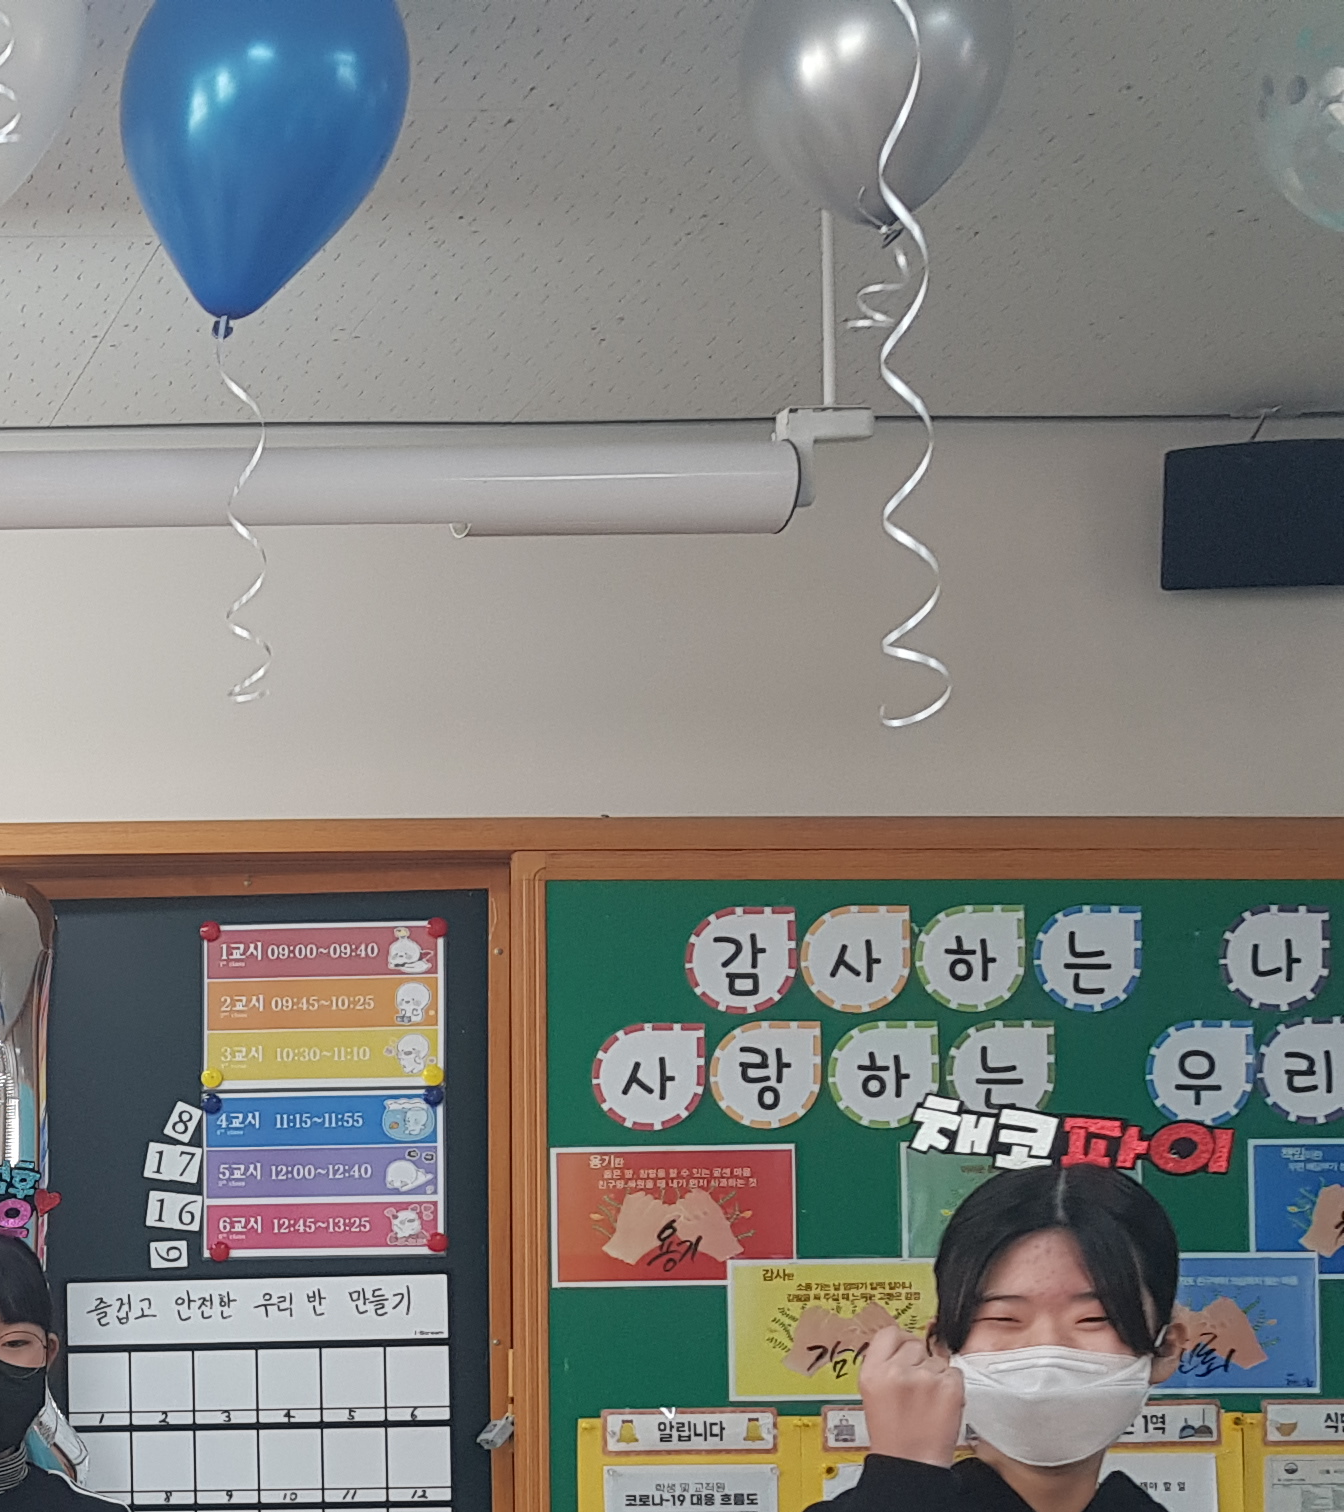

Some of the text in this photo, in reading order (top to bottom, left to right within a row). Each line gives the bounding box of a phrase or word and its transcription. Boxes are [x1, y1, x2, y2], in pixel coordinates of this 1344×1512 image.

[220, 942, 379, 961] 1교시 09:00~09:40
[1251, 939, 1303, 983] 나
[220, 994, 375, 1012] 2교시 09:45~10:25
[220, 1045, 371, 1062] 3교시 10:30~11:10
[172, 1110, 192, 1134] 8
[216, 1111, 363, 1129] 4교시 11:15~11:55
[218, 1163, 372, 1180] 5교시 12:00~12:40
[218, 1216, 371, 1233] 6교시 12:45~13:25
[86, 1294, 158, 1327] 즐겁고
[253, 1291, 294, 1318] 우리
[306, 1288, 326, 1317] 반
[348, 1285, 412, 1316] 만들기
[158, 1412, 169, 1424] 2
[221, 1411, 231, 1423] 3
[283, 1410, 295, 1423] 4
[347, 1409, 357, 1421] 5
[410, 1408, 418, 1420] 6
[657, 1420, 726, 1442] 알립니다
[164, 1489, 428, 1503] 8 9 10 11 12
[625, 1494, 686, 1506] 코로나-19
